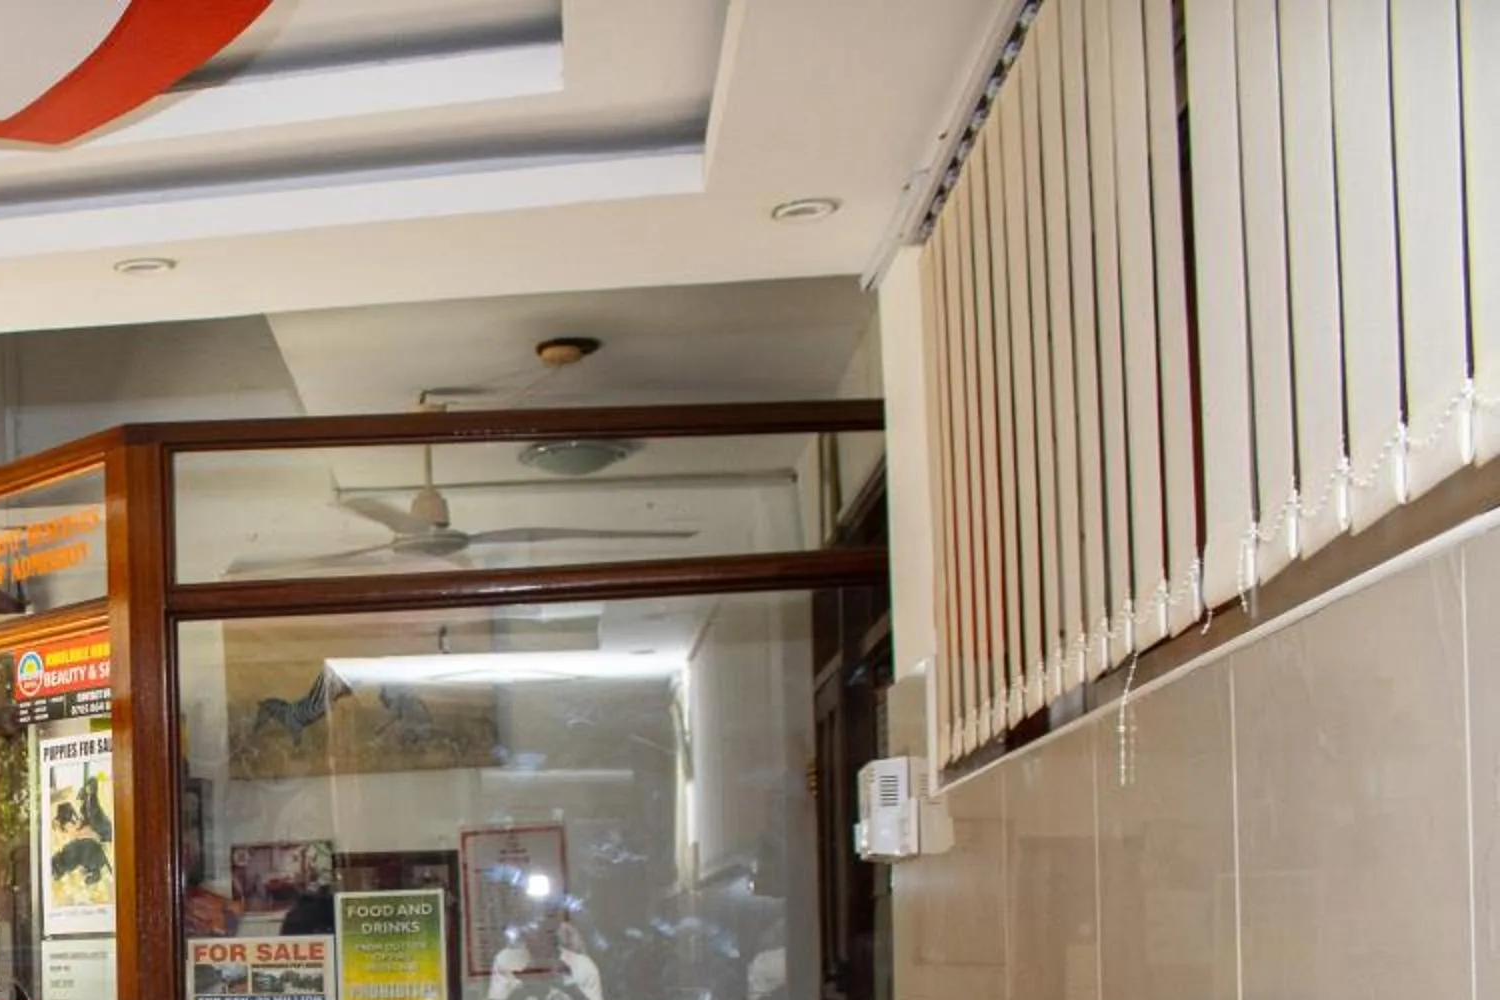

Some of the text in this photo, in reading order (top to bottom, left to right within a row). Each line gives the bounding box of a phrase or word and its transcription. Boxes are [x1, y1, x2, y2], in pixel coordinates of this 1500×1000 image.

[43, 664, 87, 688] BEAUTY
[43, 743, 77, 762] PUPPIES
[80, 740, 95, 757] FOR
[347, 903, 433, 918] FOOD AND
[361, 921, 420, 935] DRINKS
[194, 942, 325, 962] FOR SALE
